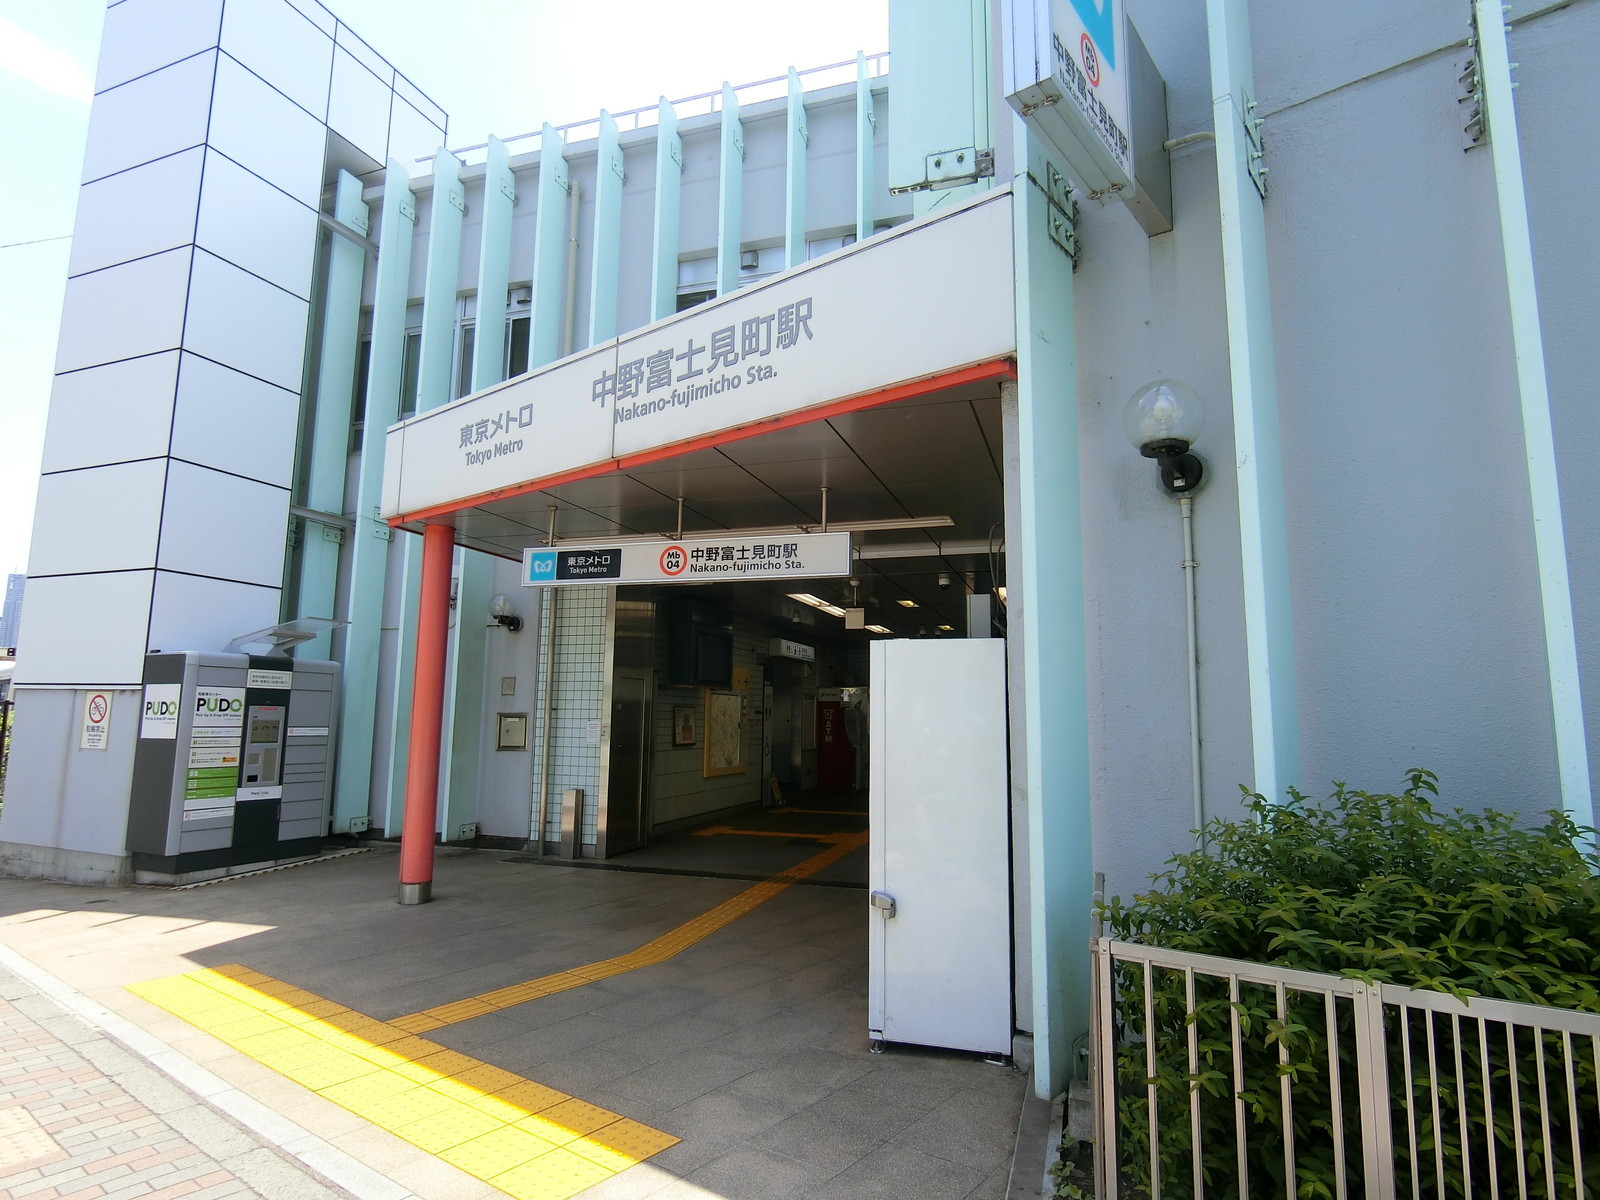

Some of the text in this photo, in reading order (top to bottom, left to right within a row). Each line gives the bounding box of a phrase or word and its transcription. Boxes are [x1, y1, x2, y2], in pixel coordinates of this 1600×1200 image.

[1085, 41, 1095, 63] Mb
[1086, 55, 1096, 78] 04
[1053, 32, 1129, 162] 中野富士見町駅
[1059, 67, 1114, 153] Nakano-fujimicho
[592, 297, 814, 408] 中野富士見町駅
[614, 365, 778, 424] Nakano-fujimicho Sta.
[459, 403, 534, 449] 東京メトロ
[466, 439, 524, 466] Tokyo Metro
[567, 555, 611, 567] 東京メトロ
[667, 551, 681, 559] Mb
[691, 543, 798, 562] 中野富士見町駅
[569, 566, 608, 575] Tokyo Metro
[667, 560, 680, 570] 04
[690, 560, 805, 573] Nakano-fujimicho Sta.
[145, 700, 177, 716] PUDO
[196, 697, 243, 712] PUDO
[825, 720, 833, 742] ATM
